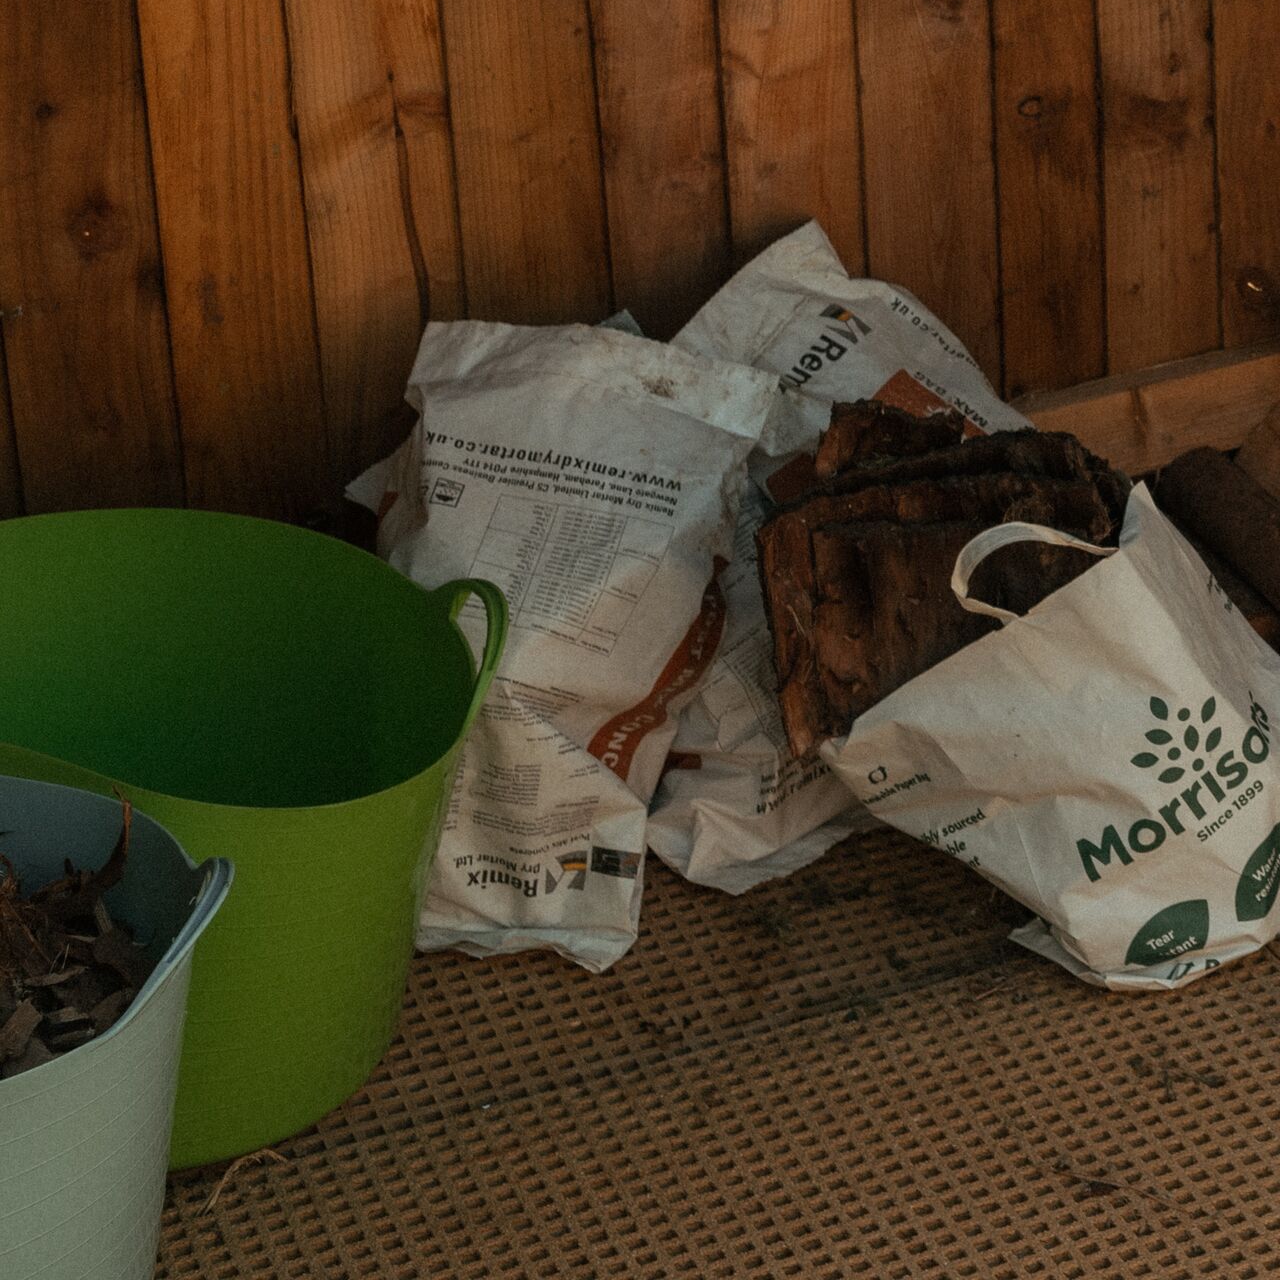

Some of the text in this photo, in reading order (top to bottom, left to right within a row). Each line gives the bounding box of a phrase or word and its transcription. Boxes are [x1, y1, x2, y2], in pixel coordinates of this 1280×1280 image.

[941, 808, 986, 836] sourced
[1196, 779, 1265, 843] Since 1899
[476, 854, 517, 871] Mortar
[465, 868, 539, 898] Remix
[1145, 930, 1175, 951] Tear
